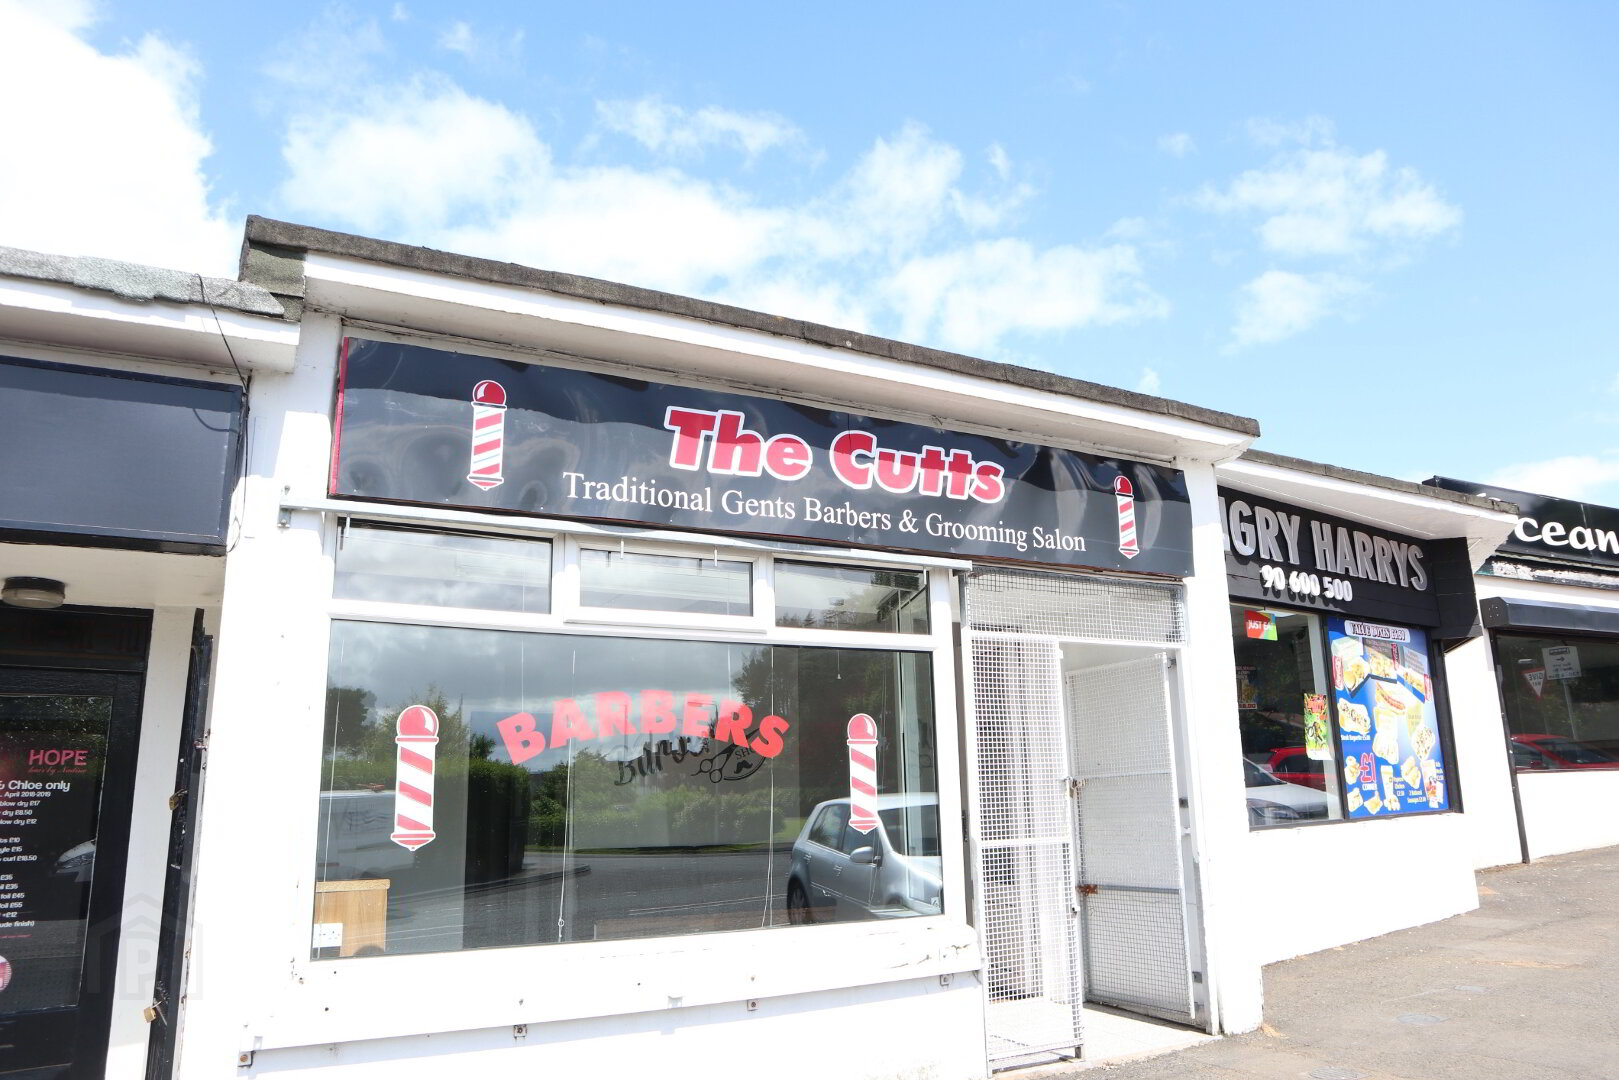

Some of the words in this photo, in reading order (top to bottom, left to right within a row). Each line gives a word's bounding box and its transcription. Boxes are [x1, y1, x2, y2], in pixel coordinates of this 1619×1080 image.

[664, 405, 813, 481] The
[829, 429, 1006, 504] Cutts
[562, 471, 713, 513] Traditional
[721, 490, 796, 520] Gents
[803, 497, 892, 531] Barbers
[899, 509, 919, 534] &
[925, 513, 1028, 552] Grooming
[1032, 526, 1087, 552] Salon
[1310, 520, 1428, 591] HARRYS
[1260, 564, 1286, 591] 90
[1288, 571, 1321, 597] 600
[1322, 576, 1354, 602] 500
[1247, 619, 1262, 630] JUST
[496, 689, 790, 766] BARBERS
[28, 749, 88, 766] HOPE
[4, 791, 20, 799] April
[8, 780, 43, 790] Chloe
[45, 780, 71, 792] only
[17, 800, 29, 808] dry
